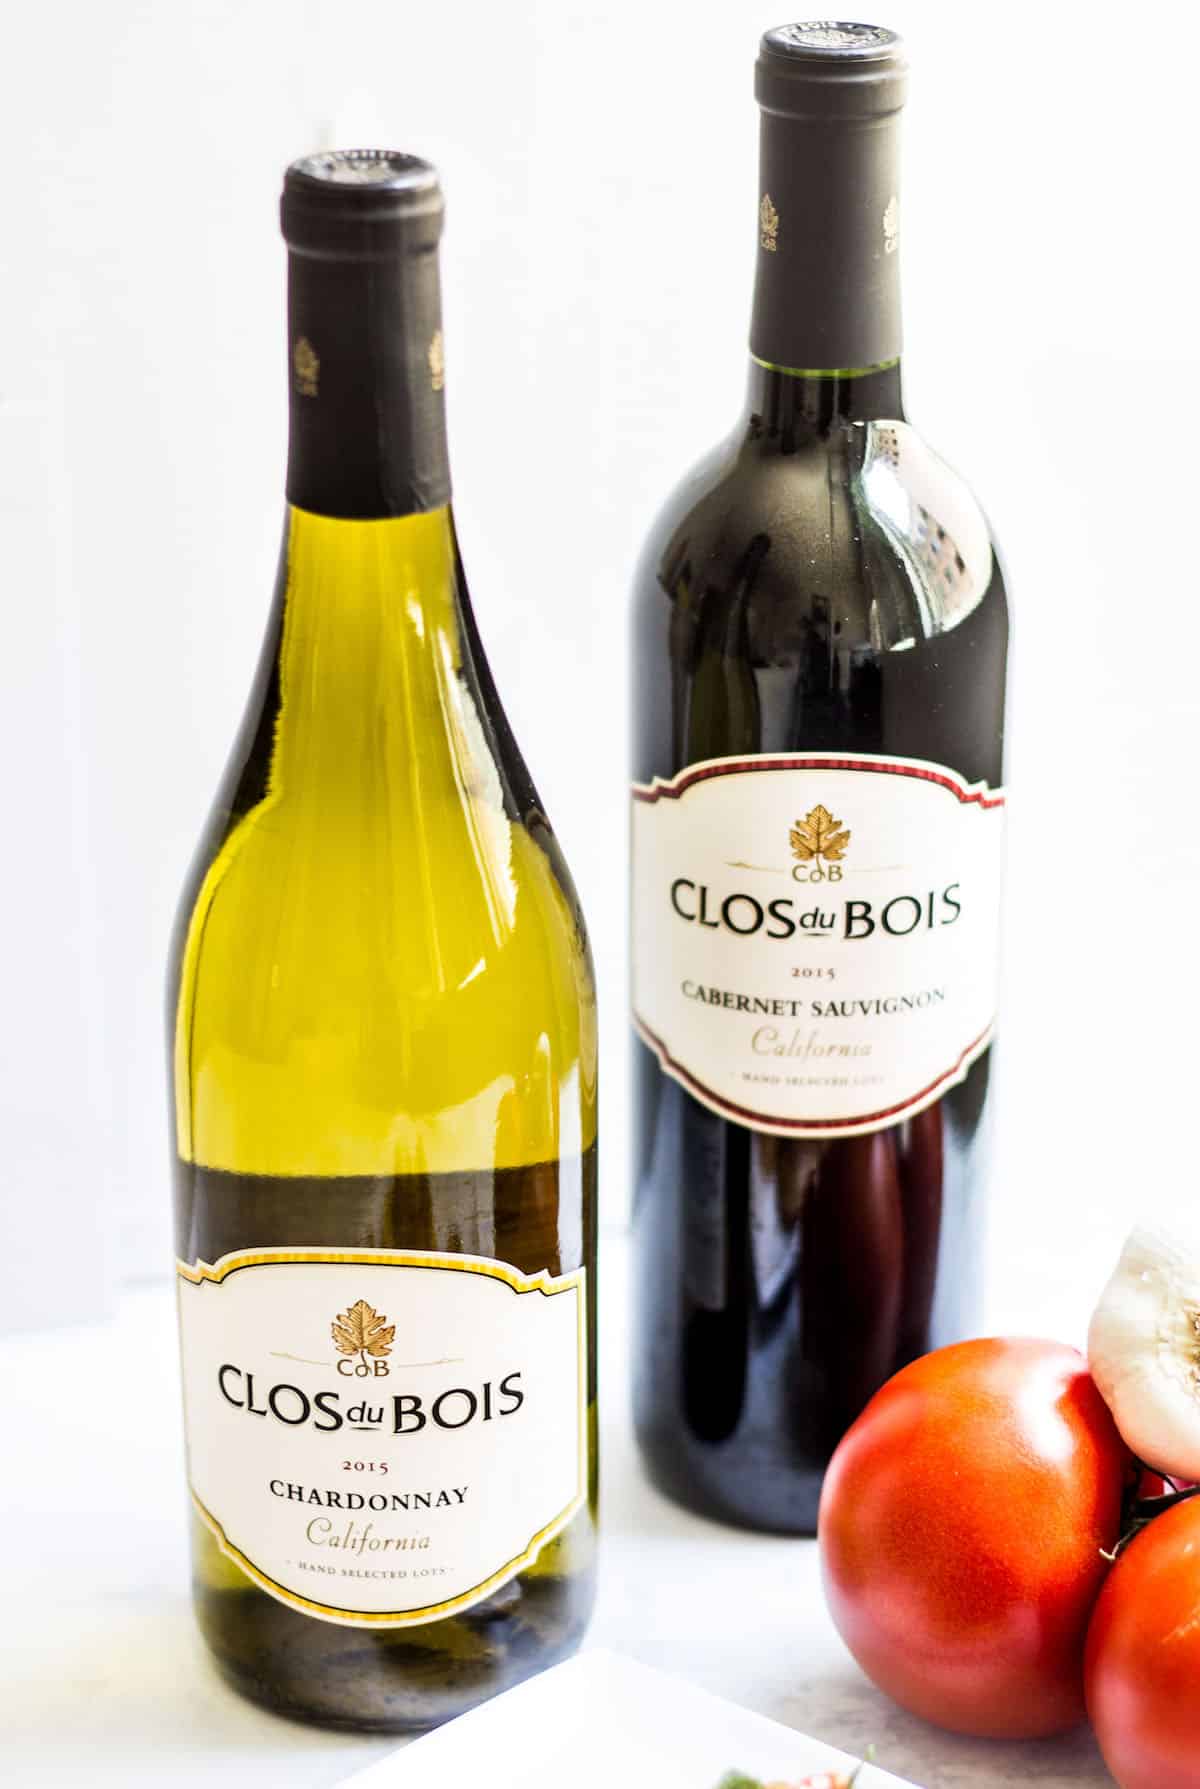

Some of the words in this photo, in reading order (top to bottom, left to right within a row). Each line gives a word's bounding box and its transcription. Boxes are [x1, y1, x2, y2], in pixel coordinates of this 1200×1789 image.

[670, 878, 796, 940] CLOS
[799, 907, 836, 930] du
[843, 882, 961, 940] BOIS
[791, 967, 836, 980] 2015
[681, 979, 802, 1018] CABERNET
[811, 986, 946, 1018] SAUVIGNON
[751, 1025, 873, 1062] California
[217, 1363, 344, 1432] CLOS
[346, 1400, 384, 1425] du
[392, 1371, 525, 1434] BOIS
[342, 1459, 389, 1475] 2015
[269, 1478, 470, 1511] CHARDONNAY
[305, 1516, 432, 1557] California
[298, 1560, 337, 1575] HAND
[341, 1567, 408, 1580] SELECTED
[412, 1567, 447, 1578] LOTS
